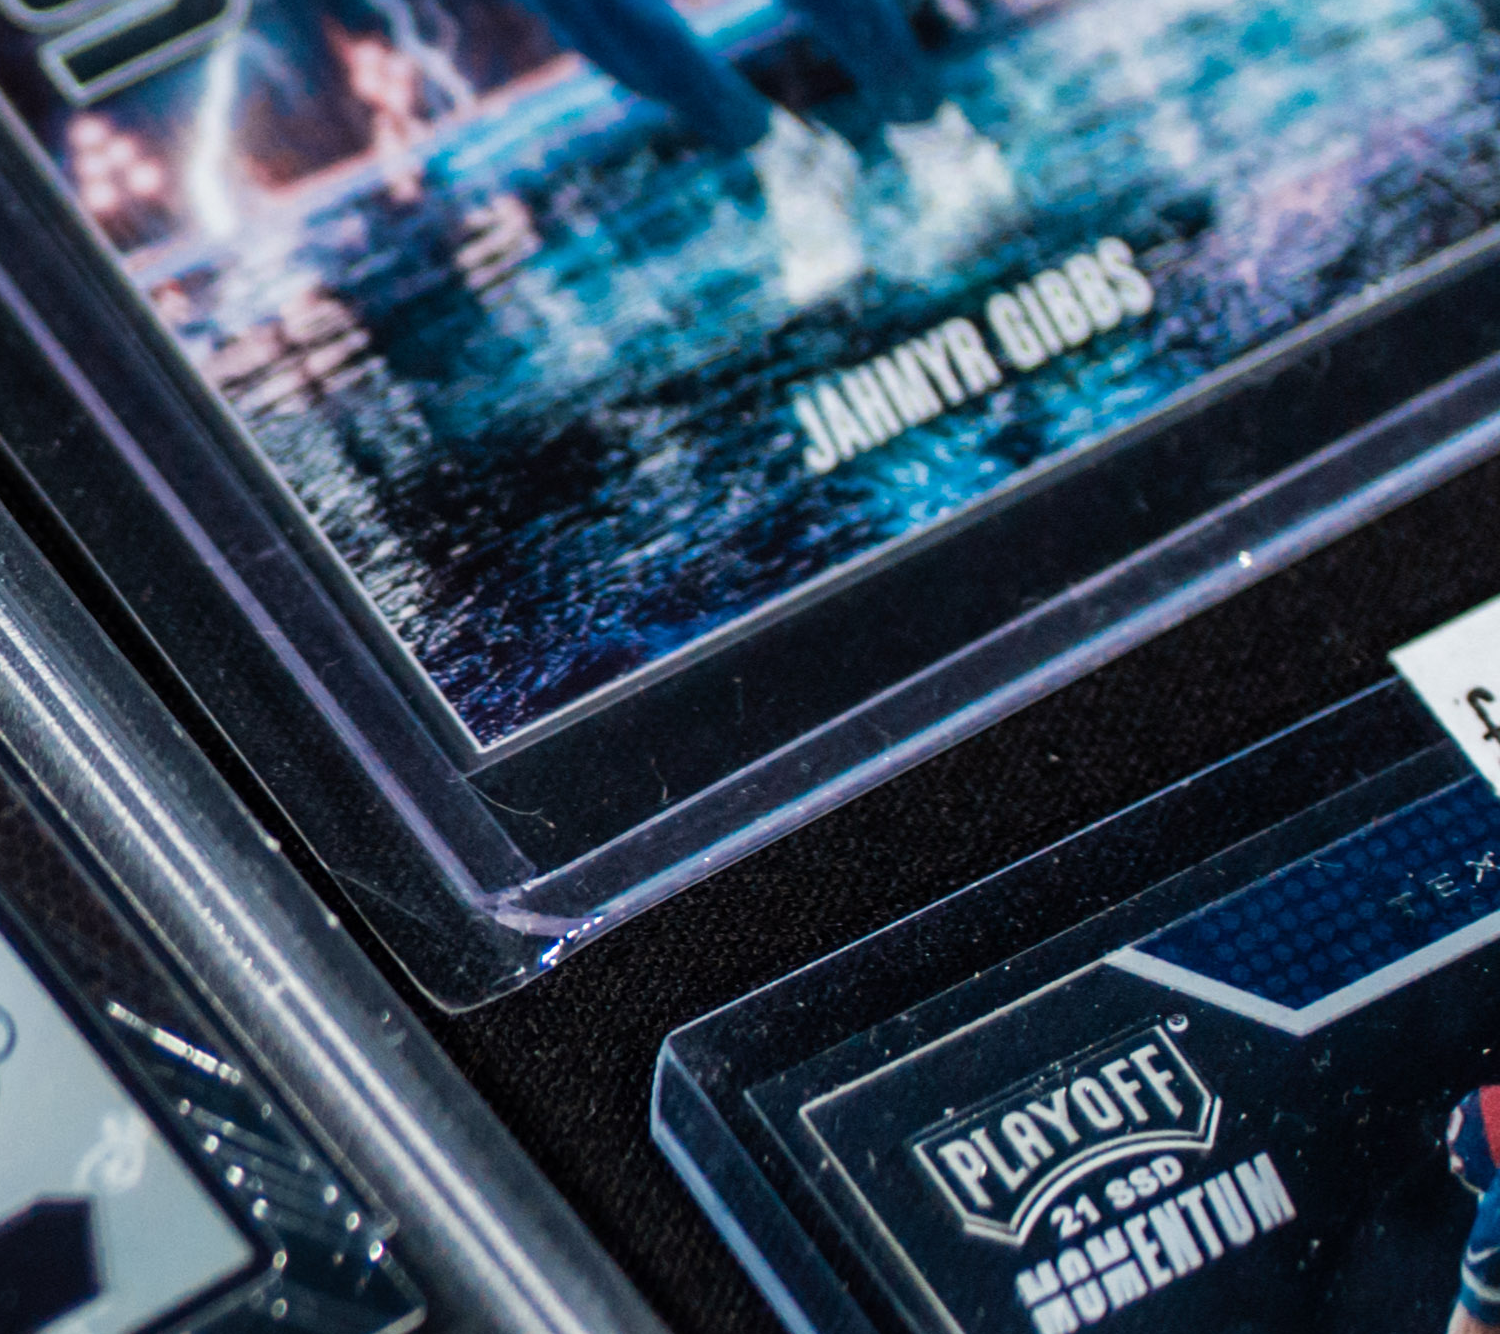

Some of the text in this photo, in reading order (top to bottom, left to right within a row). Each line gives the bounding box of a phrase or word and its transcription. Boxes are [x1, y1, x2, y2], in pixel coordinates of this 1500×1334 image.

[793, 235, 1155, 476] JAHMYR GIBBS
[938, 1042, 1184, 1209] PLAYOFF
[1050, 1154, 1184, 1240] 21 SSD
